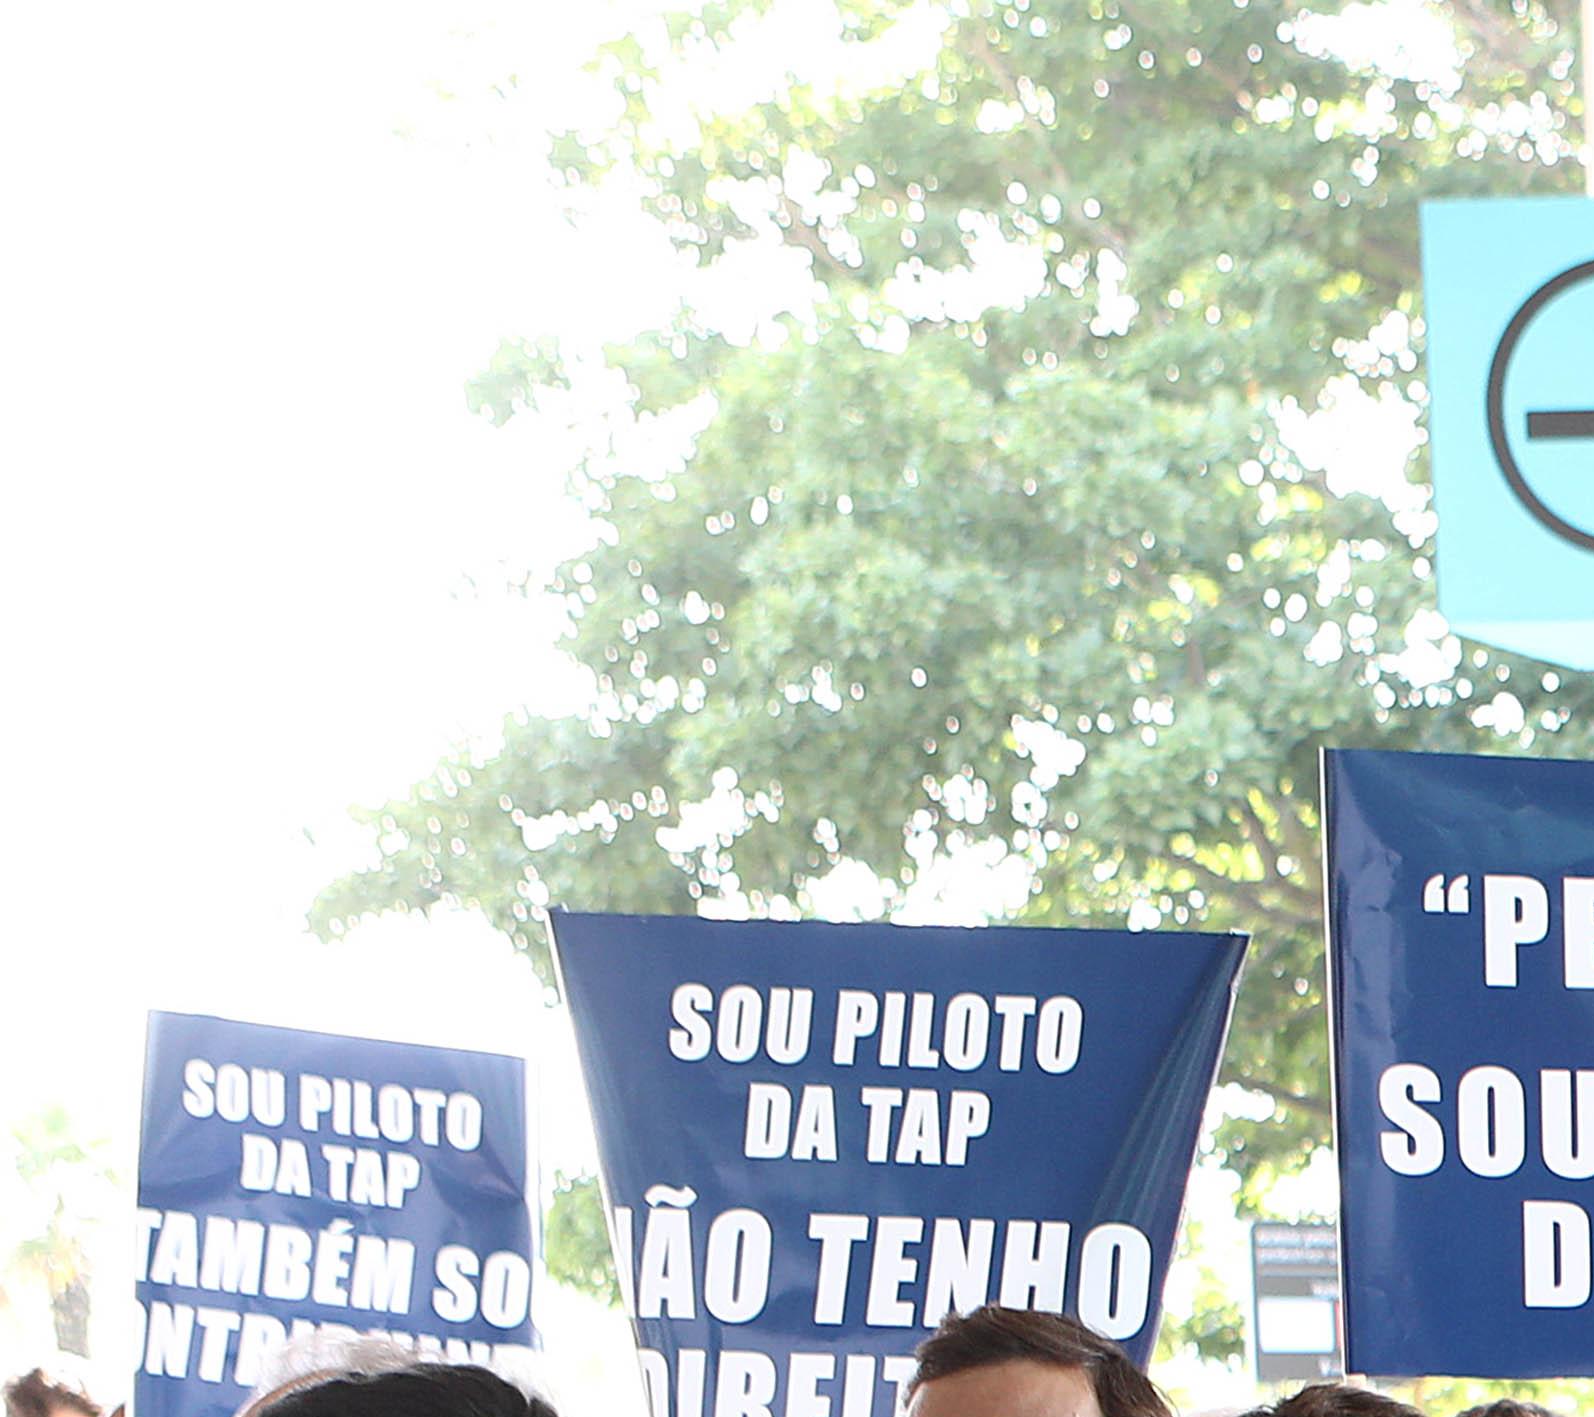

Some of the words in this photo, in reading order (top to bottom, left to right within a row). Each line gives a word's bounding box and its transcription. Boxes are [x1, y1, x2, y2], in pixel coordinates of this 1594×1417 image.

[668, 983, 814, 1065] SOU
[832, 989, 1083, 1074] PILOTO
[181, 1057, 286, 1127] SOU
[296, 1072, 483, 1152] PILOTO
[744, 1082, 838, 1162] DA
[861, 1086, 991, 1166] TAP
[239, 1129, 312, 1198] DA
[321, 1143, 421, 1209] TAP
[432, 1243, 536, 1329] SO
[807, 1213, 1152, 1341] TENHO
